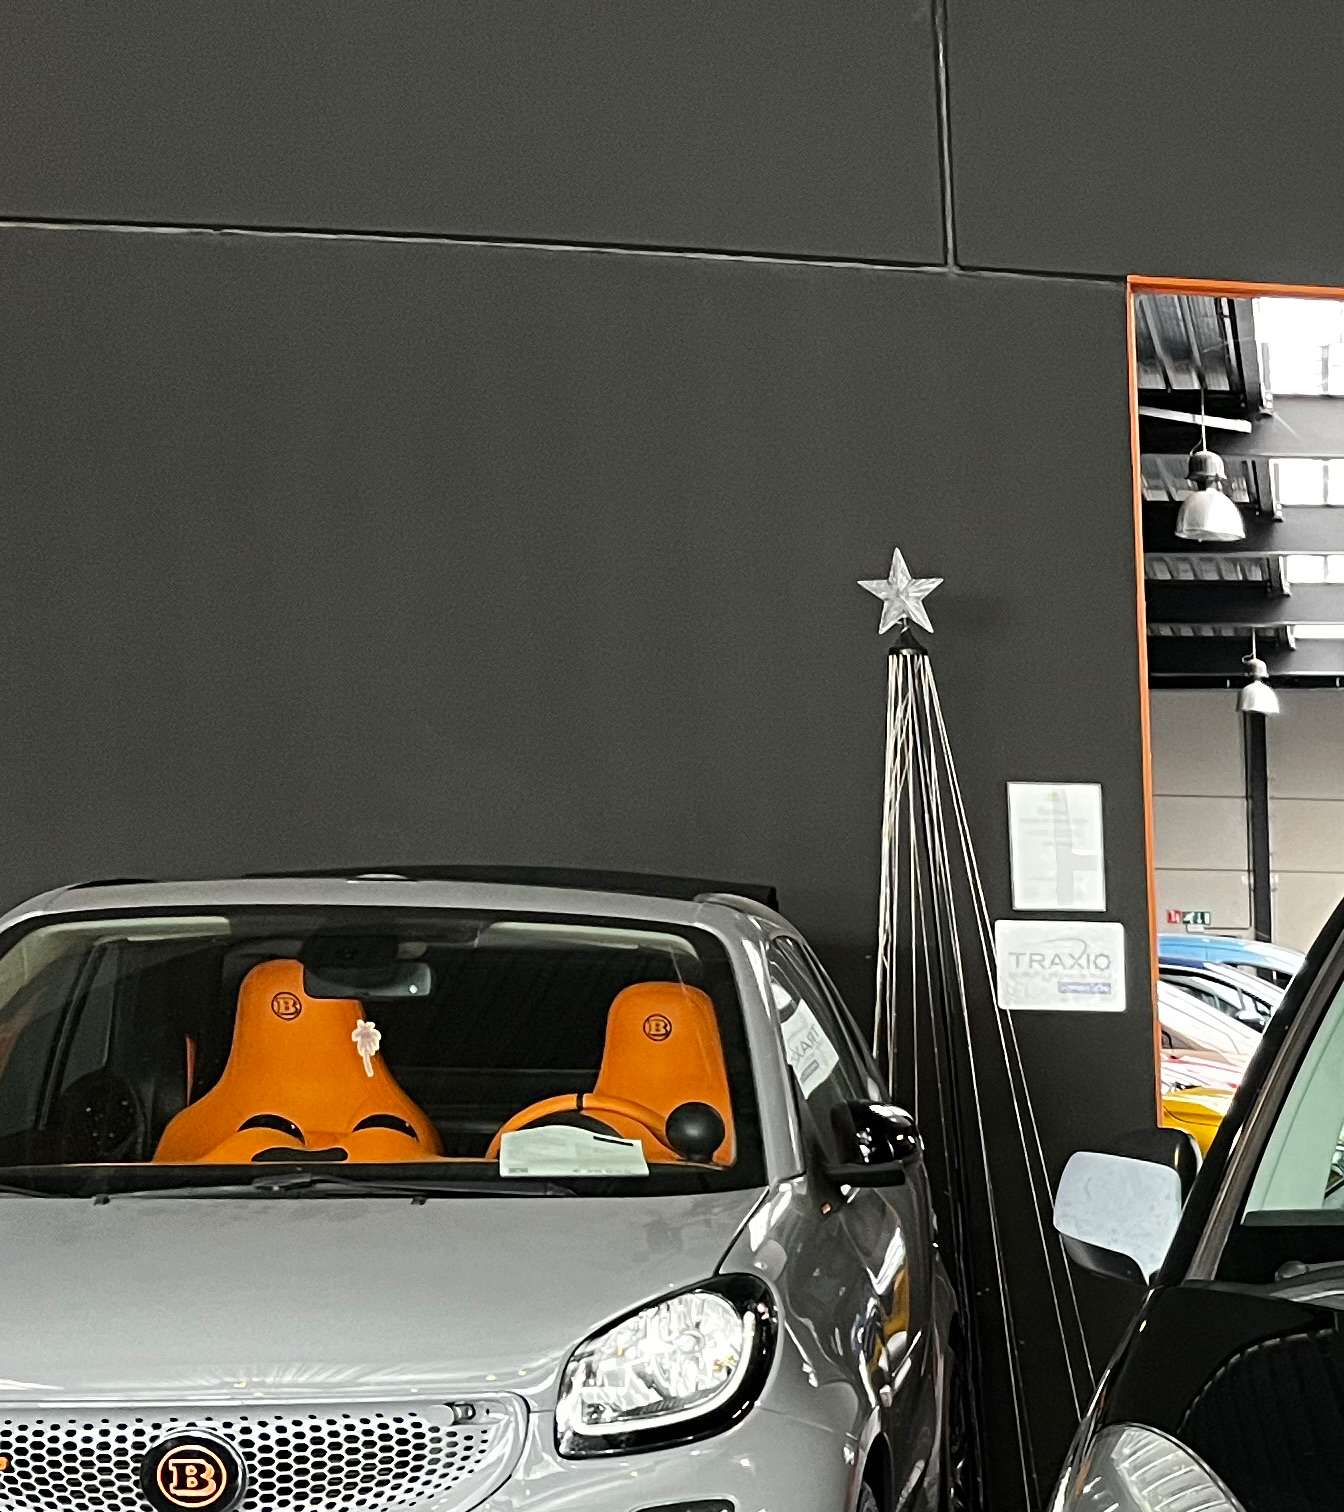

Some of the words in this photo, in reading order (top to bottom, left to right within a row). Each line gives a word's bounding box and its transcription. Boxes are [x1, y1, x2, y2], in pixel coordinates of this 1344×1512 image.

[1008, 952, 1111, 971] TRAXIO
[647, 1018, 670, 1037] B
[168, 1458, 217, 1497] B
